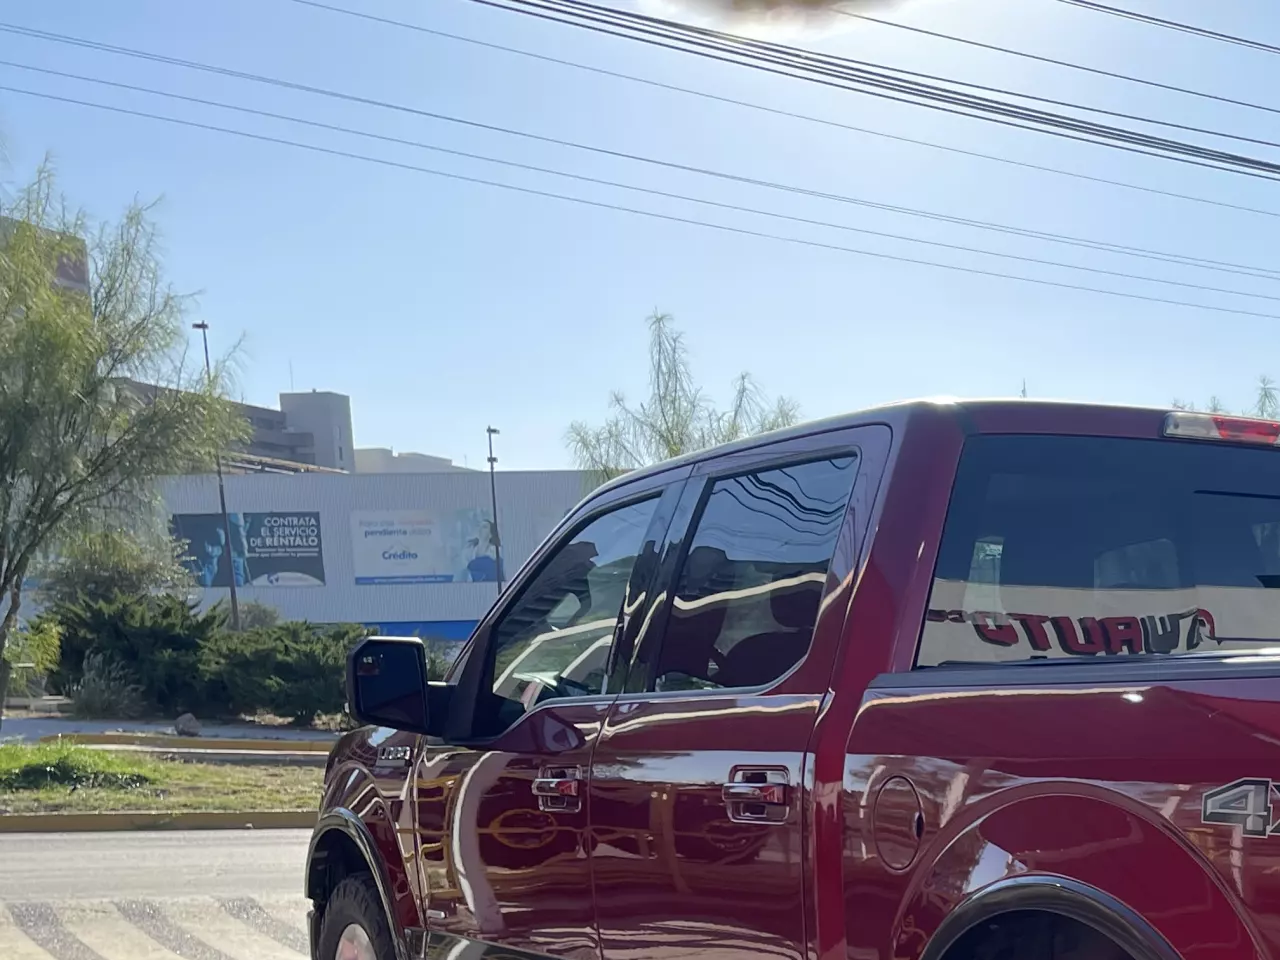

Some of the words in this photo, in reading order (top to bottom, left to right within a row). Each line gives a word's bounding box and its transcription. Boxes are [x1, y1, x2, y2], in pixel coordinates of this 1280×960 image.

[264, 516, 317, 526] CONTRATA
[261, 526, 271, 537] EL
[273, 526, 318, 537] SERVICIO
[250, 537, 262, 547] DE
